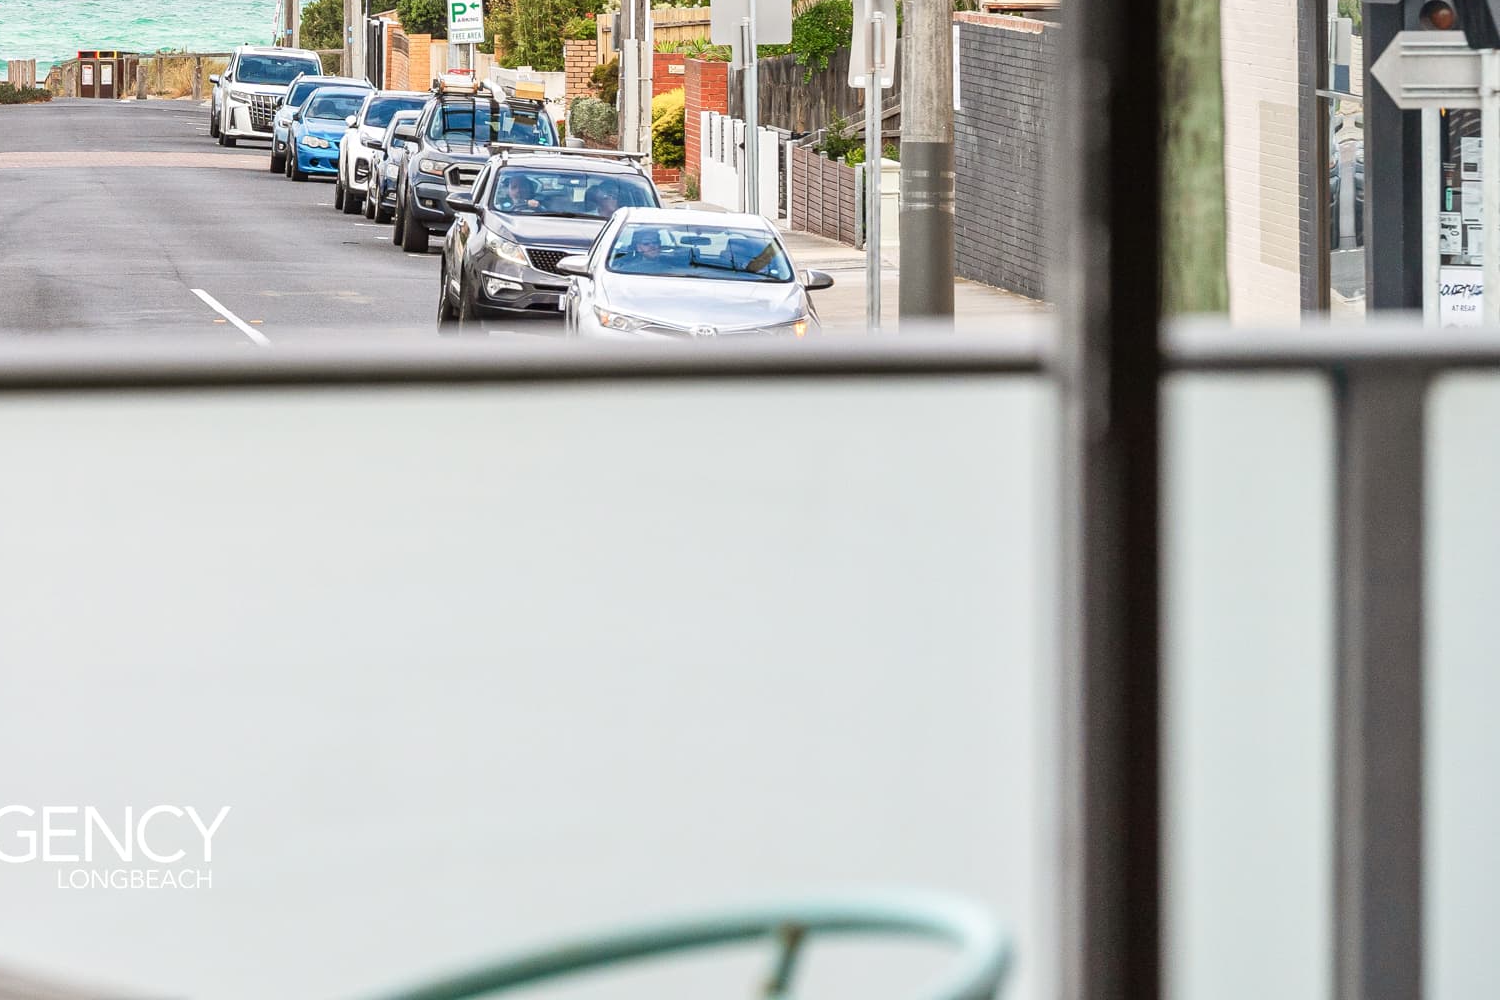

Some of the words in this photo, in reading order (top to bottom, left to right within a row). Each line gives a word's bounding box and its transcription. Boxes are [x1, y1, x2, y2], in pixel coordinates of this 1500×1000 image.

[452, 33, 466, 41] FREE
[467, 32, 482, 40] AREA
[1451, 304, 1459, 312] AT
[1460, 304, 1477, 312] REAR
